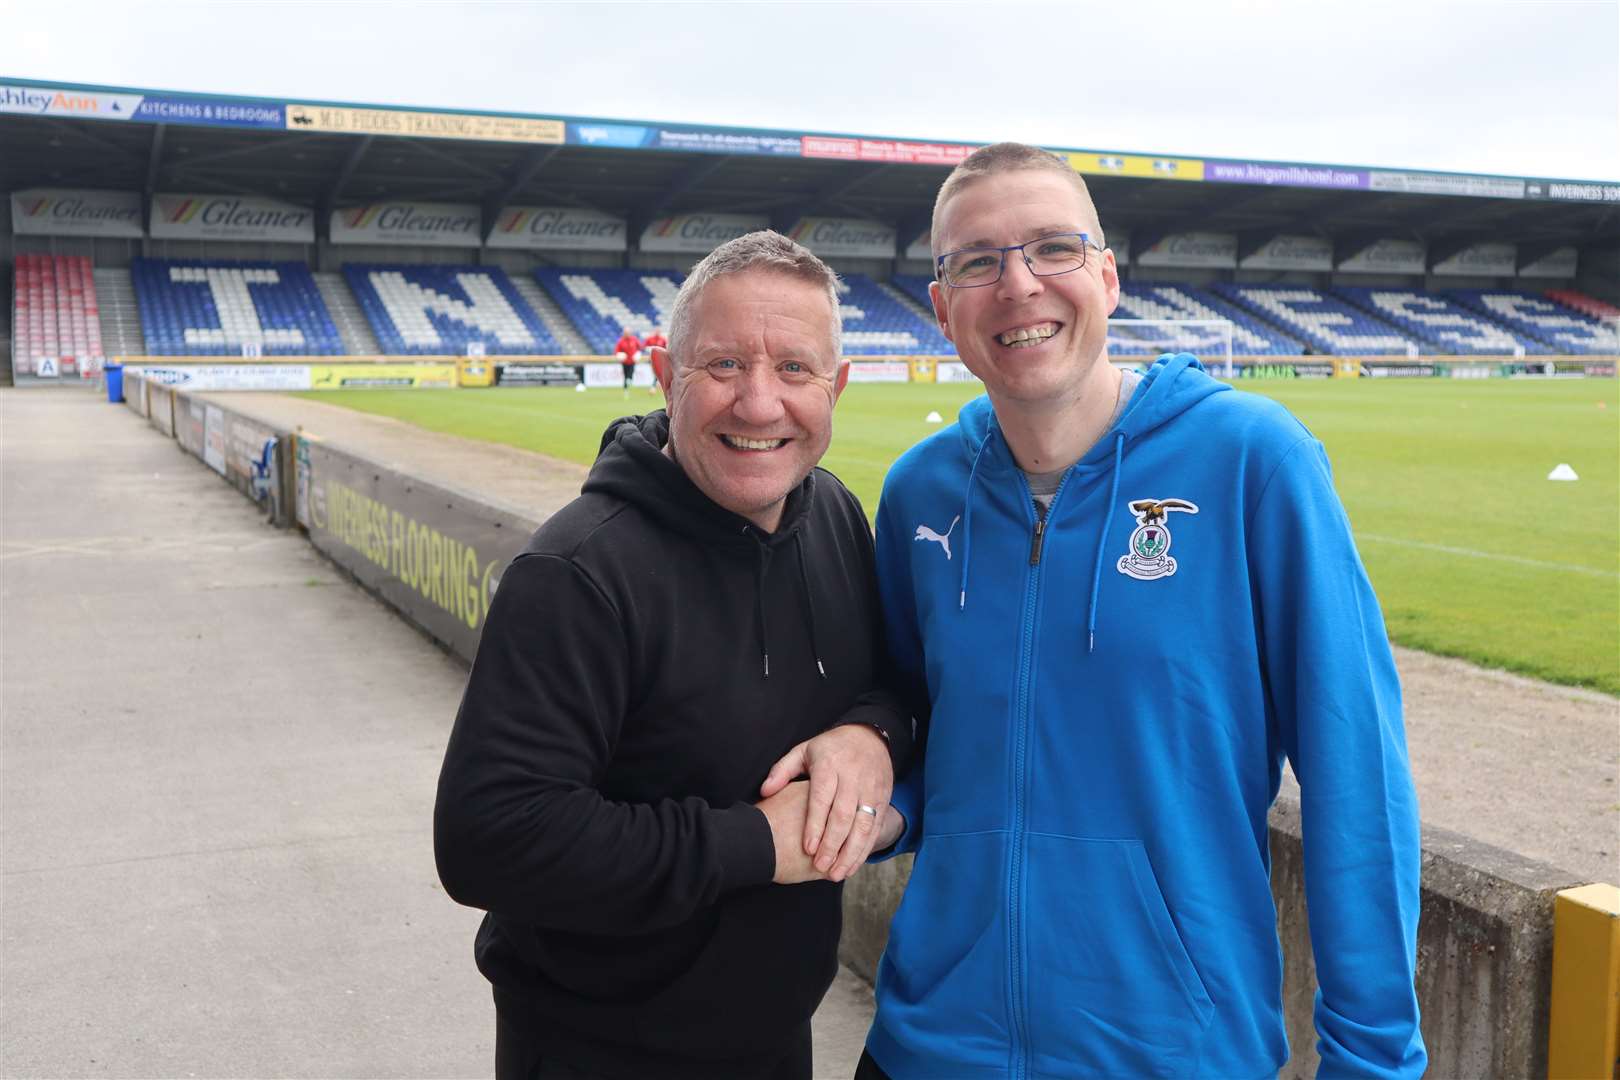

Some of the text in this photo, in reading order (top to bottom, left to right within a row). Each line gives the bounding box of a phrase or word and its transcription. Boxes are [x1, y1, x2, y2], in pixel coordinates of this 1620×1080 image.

[140, 103, 281, 122] KITCHENS & BEDROOMS
[1214, 164, 1359, 186] www.kingsmillshotel.com
[1549, 184, 1602, 200] INVERNESS
[52, 199, 138, 222] Gleaner
[201, 199, 310, 229] Gleaner
[377, 206, 477, 233] Gleaner
[530, 210, 625, 238] Gleaner
[812, 218, 890, 244] Gleaner
[42, 360, 54, 372] A
[327, 479, 480, 629] INVERNESS FLOORING
